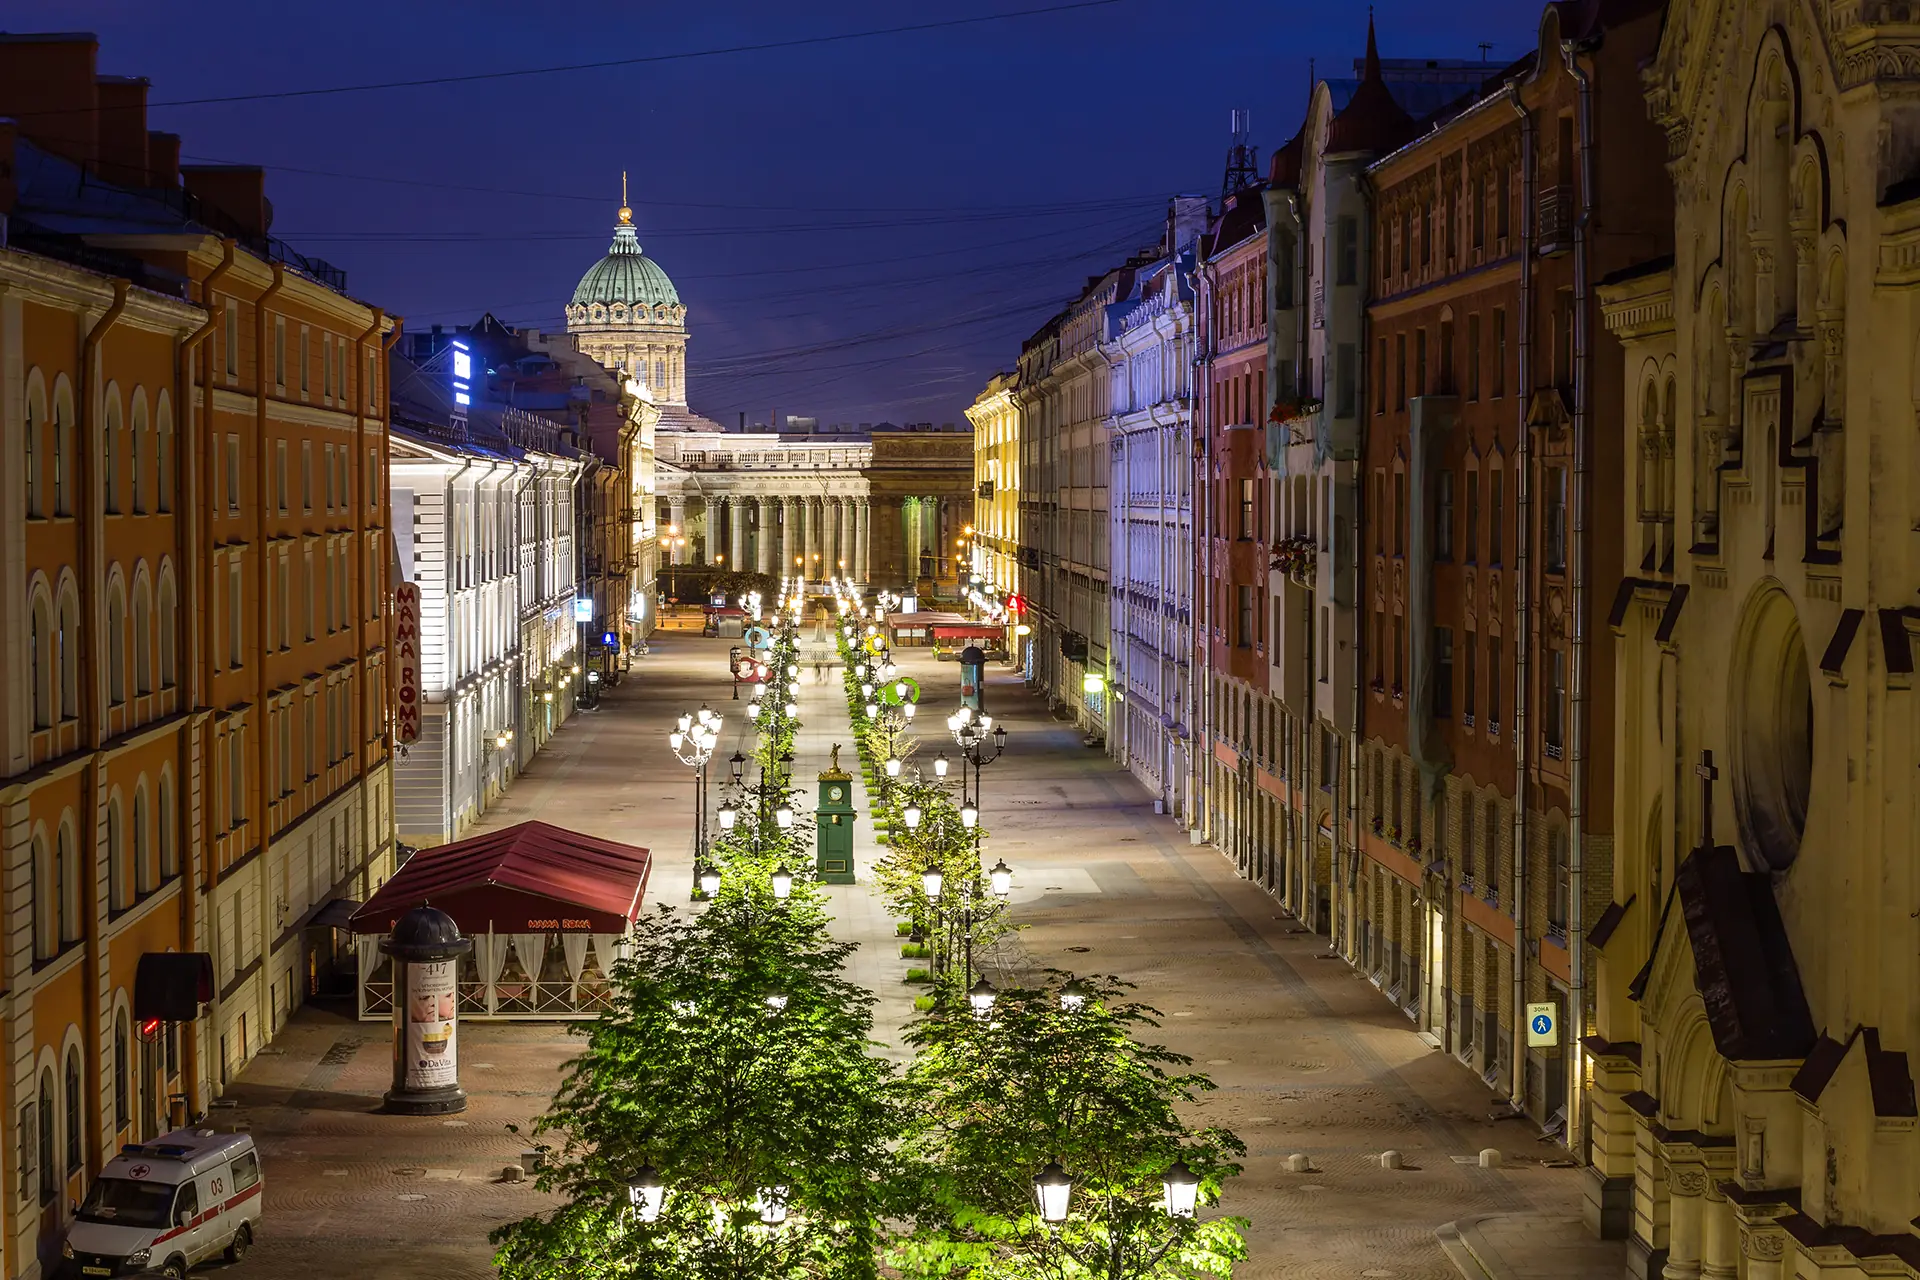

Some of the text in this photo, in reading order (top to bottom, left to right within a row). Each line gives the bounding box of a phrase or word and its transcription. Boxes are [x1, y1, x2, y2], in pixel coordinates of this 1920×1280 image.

[396, 587, 417, 740] MAMA ROMA
[527, 918, 592, 929] MAMA ROMA
[210, 1177, 224, 1196] 03
